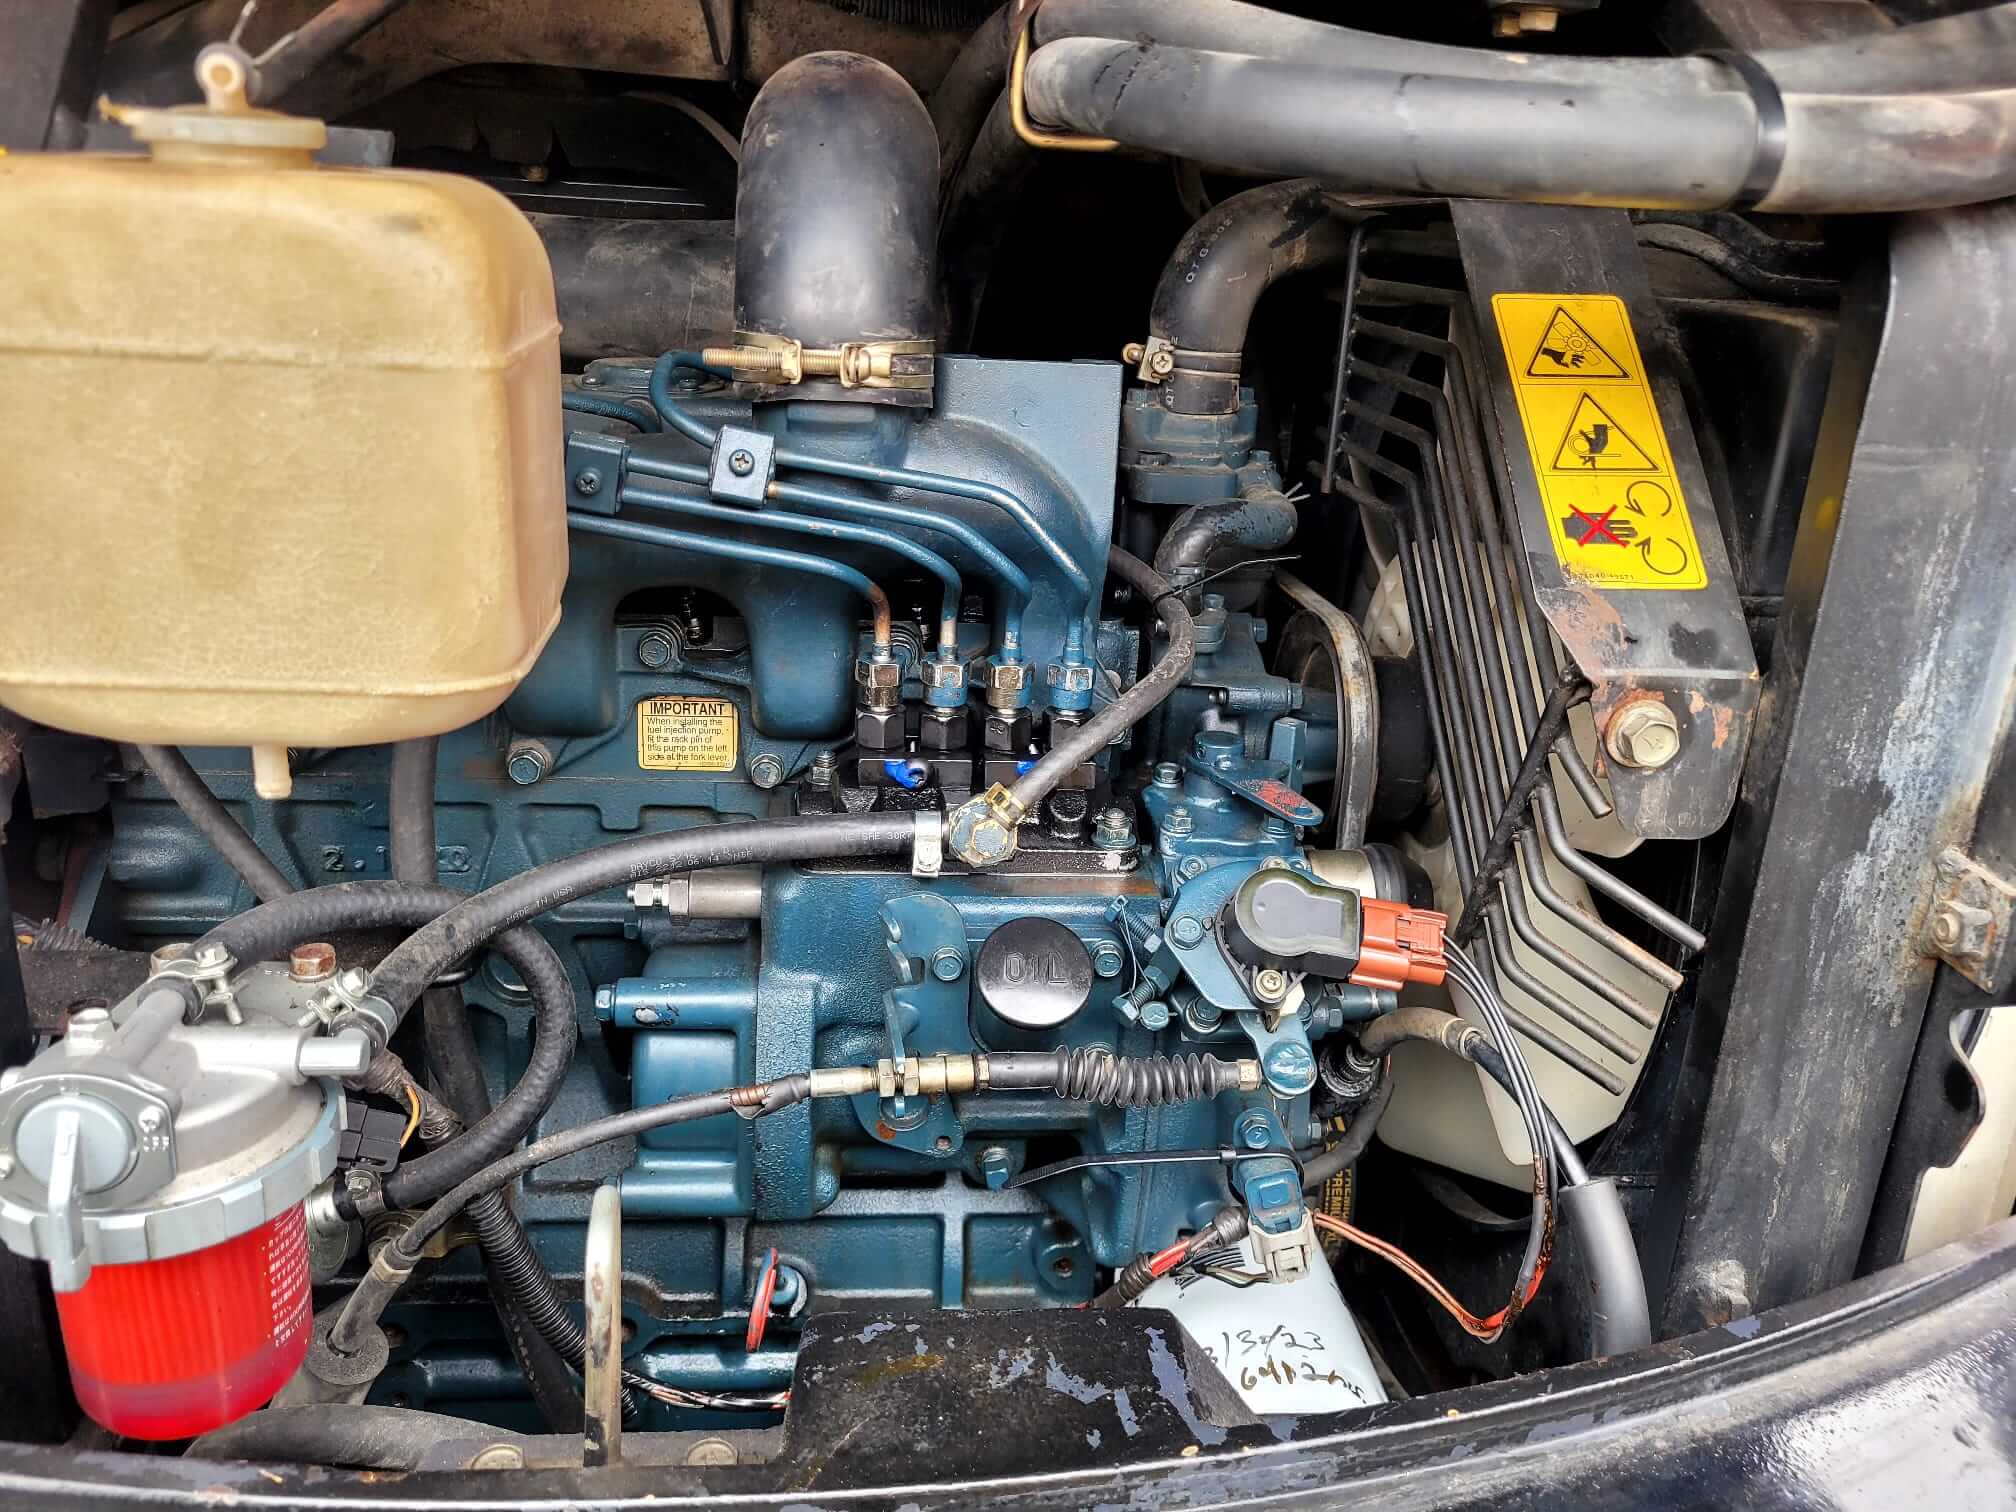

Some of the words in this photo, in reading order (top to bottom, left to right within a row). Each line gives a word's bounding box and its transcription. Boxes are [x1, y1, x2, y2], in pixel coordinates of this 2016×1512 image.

[650, 701, 725, 715] IMPORTANT
[647, 717, 671, 726] When
[673, 717, 708, 727] installing
[709, 718, 723, 726] the
[647, 726, 662, 734] fuel
[663, 726, 697, 735] injection
[656, 735, 669, 743] the
[671, 735, 688, 743] rack
[691, 735, 702, 744] pin
[704, 735, 713, 743] of
[647, 744, 662, 752] this
[663, 744, 686, 753] pump
[700, 744, 713, 752] the
[715, 744, 727, 753] left
[647, 753, 664, 761] side
[676, 753, 689, 761] the
[690, 753, 706, 761] fork
[1003, 951, 1069, 984] OIL
